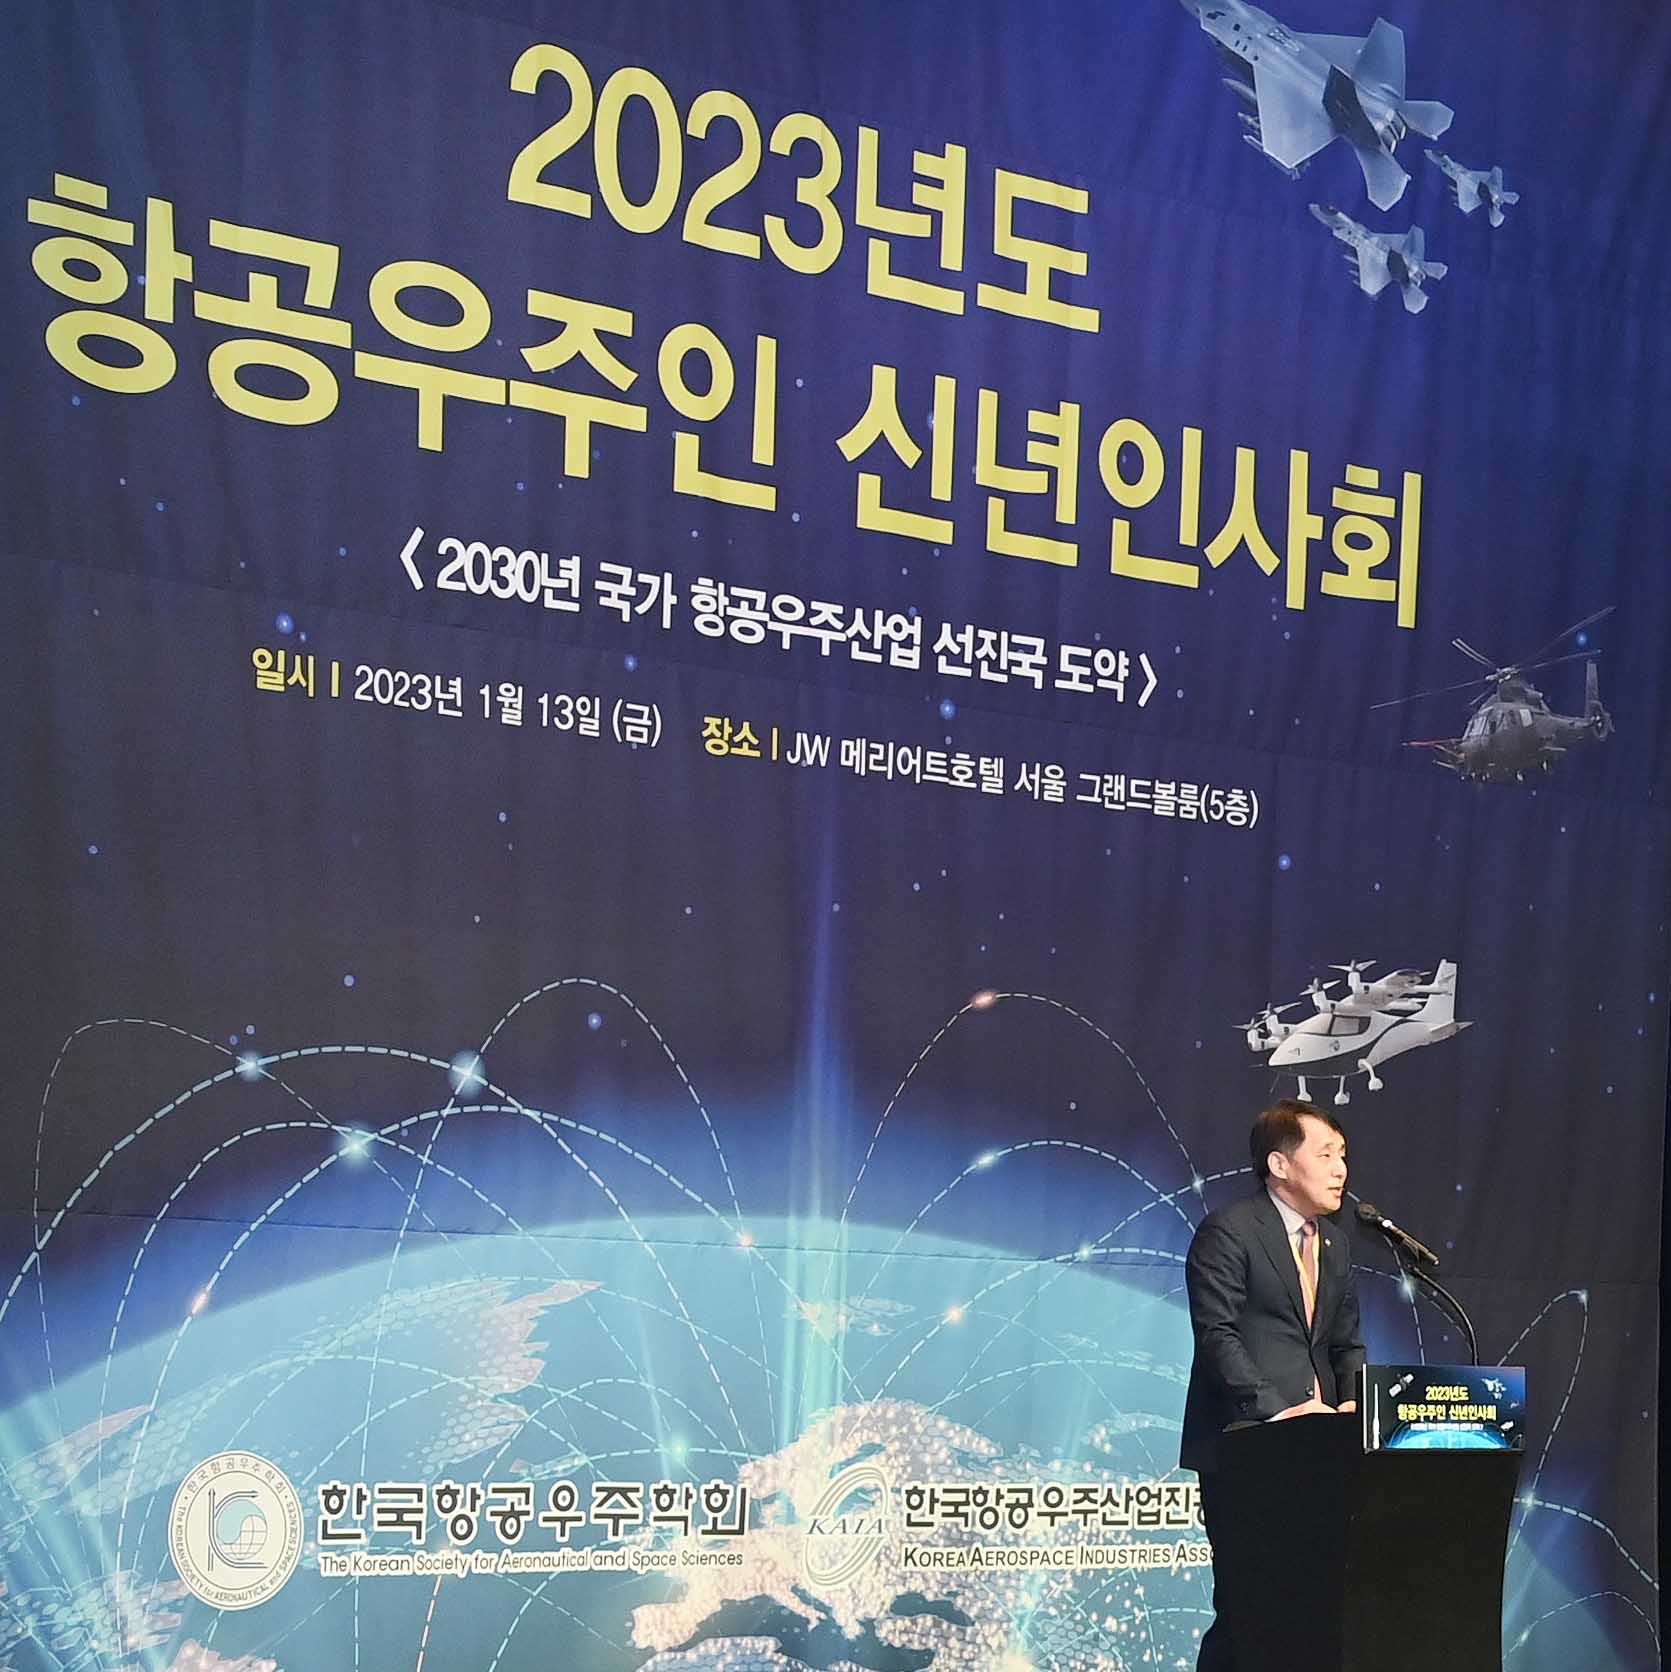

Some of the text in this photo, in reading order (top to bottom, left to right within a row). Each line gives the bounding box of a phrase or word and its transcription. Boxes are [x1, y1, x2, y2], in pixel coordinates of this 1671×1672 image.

[507, 42, 1101, 333] 2023년도
[26, 171, 1424, 629] 항공우주인 신년인사회
[437, 537, 582, 612] 2030년
[594, 562, 678, 629] 국가
[690, 577, 922, 669] 항공우주산업
[932, 622, 1048, 690] 선진국
[1054, 643, 1131, 703] 도약
[252, 647, 663, 748] 일시 2023년 1월 13일 (금)
[701, 714, 1260, 829] 장소 JW 메리어트호텔 서울 그랜드볼룸(5층)
[1397, 1404, 1497, 1421] 항공우주인 신년인사회
[1425, 1385, 1470, 1402] 2023년도
[320, 1482, 749, 1543] 한국항공우주학회
[806, 1517, 887, 1536] KAIA
[321, 1548, 744, 1577] The Korean Society for Aeronautical and Space Sciences
